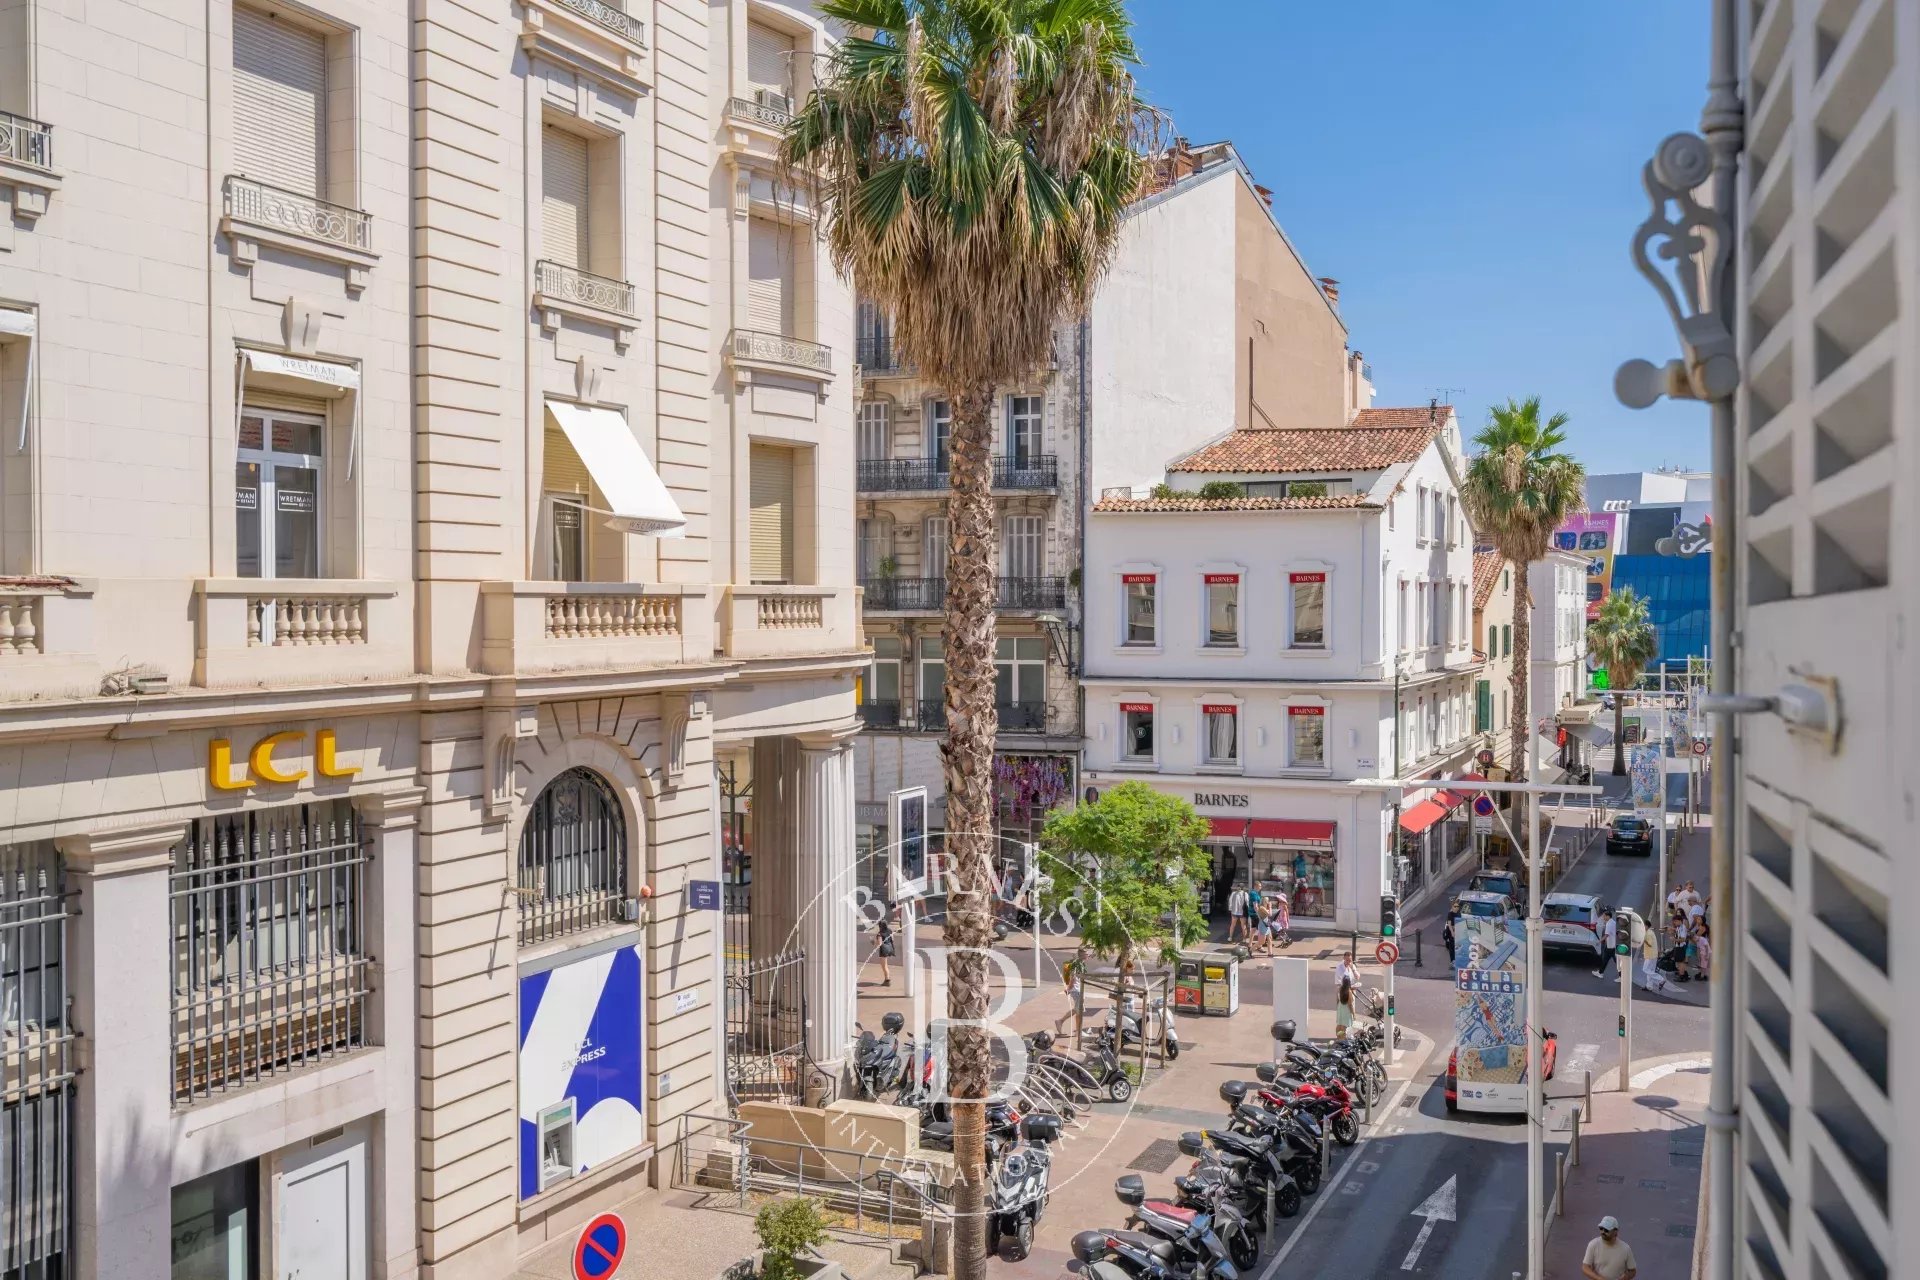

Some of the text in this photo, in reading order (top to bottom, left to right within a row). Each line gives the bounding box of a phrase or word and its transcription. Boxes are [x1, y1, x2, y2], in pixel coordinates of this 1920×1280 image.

[280, 359, 336, 377] WRETMAN
[279, 495, 312, 504] WRETMAN
[209, 729, 363, 790] LCL
[1194, 792, 1249, 807] BARNES
[1460, 969, 1489, 981] été
[1460, 982, 1520, 992] cannes
[574, 1037, 592, 1051] LCL
[560, 1046, 607, 1072] EXPRESS
